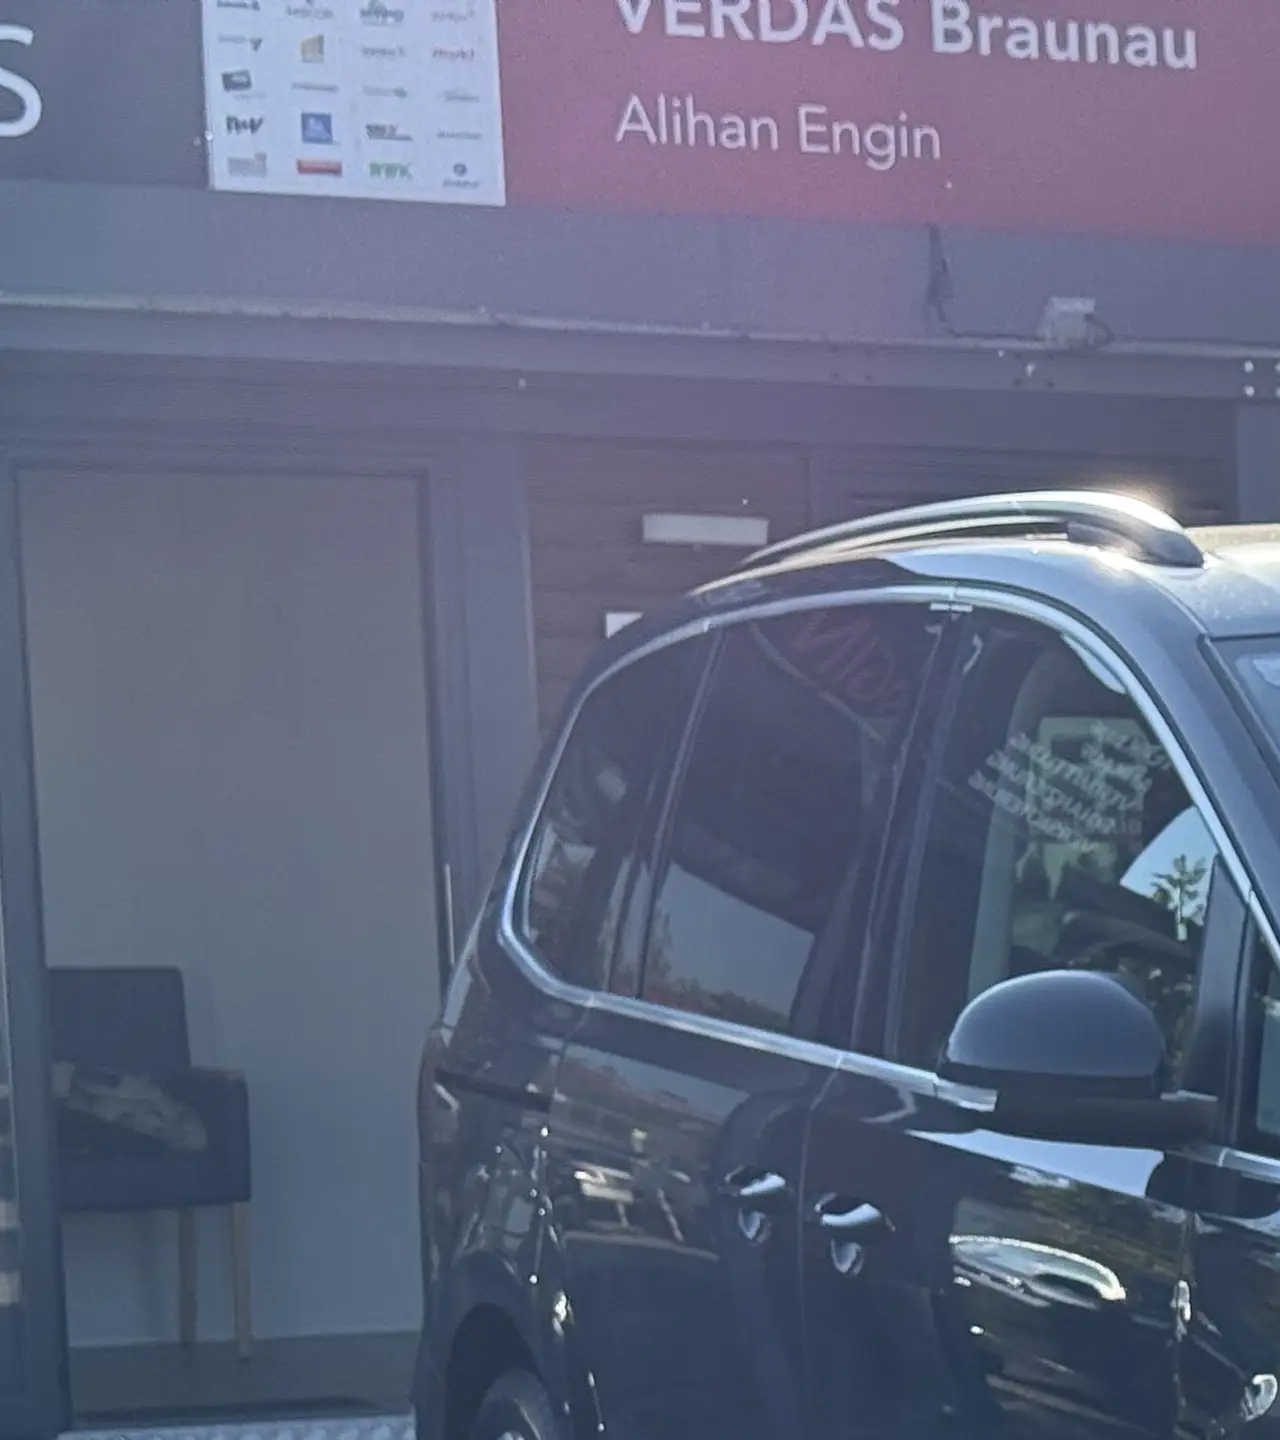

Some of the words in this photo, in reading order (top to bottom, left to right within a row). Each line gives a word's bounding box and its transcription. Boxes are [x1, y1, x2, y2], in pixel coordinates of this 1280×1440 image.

[616, 0, 905, 51] VERDAS
[930, 0, 1198, 69] Braunau
[615, 93, 779, 151] Alihan
[798, 103, 941, 171] Engin
